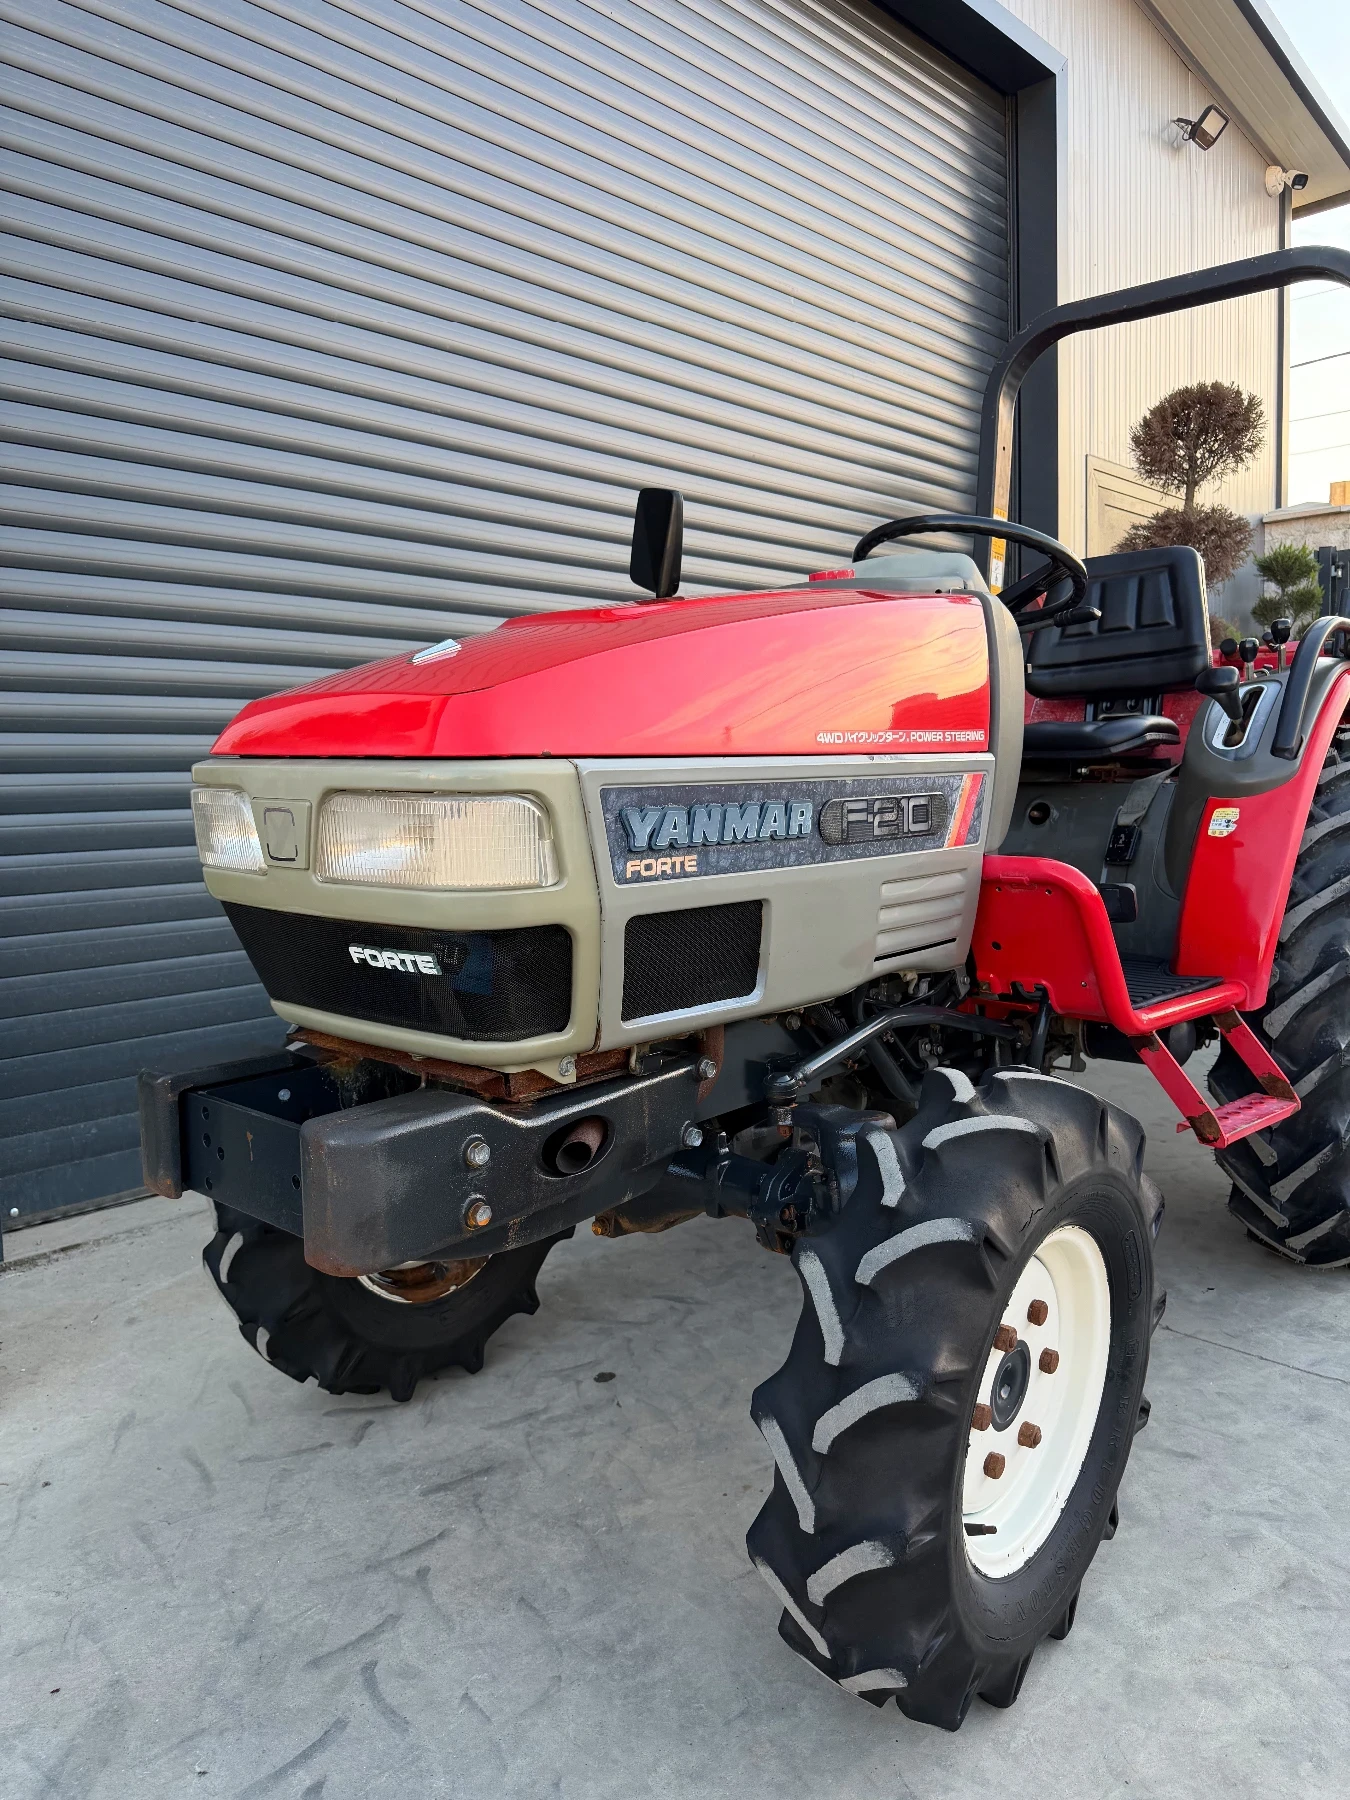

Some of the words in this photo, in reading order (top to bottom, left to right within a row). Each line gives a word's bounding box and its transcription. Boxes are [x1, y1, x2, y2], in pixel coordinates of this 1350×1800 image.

[816, 732, 843, 744] 4WD
[910, 731, 943, 742] POWER
[944, 730, 985, 741] STEERING
[620, 800, 813, 852] YANMAR
[626, 855, 698, 878] FORTE
[348, 943, 442, 976] FORTE
